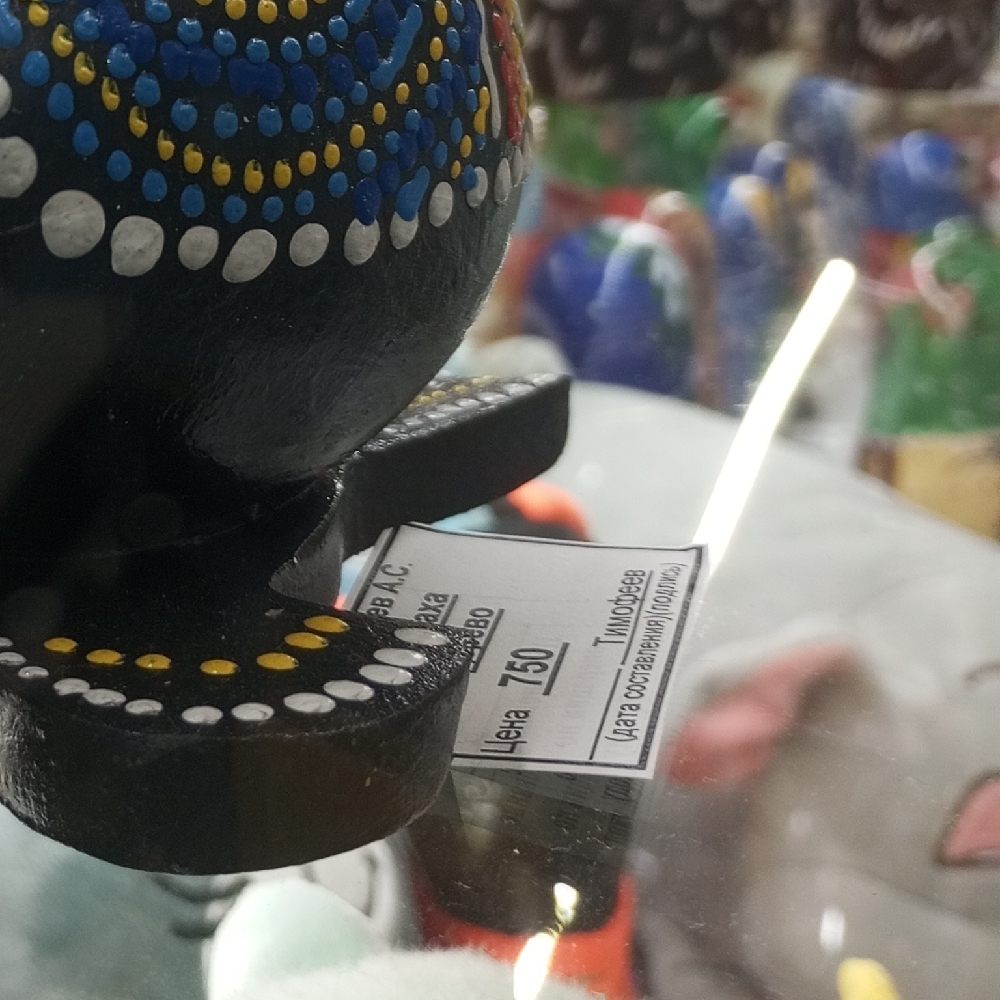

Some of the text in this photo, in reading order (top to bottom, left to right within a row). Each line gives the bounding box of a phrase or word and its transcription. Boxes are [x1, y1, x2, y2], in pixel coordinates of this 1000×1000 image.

[591, 569, 646, 647] Тимофеев
[497, 647, 554, 687] 750
[480, 709, 531, 754] Цена
[604, 703, 641, 742] (дата
